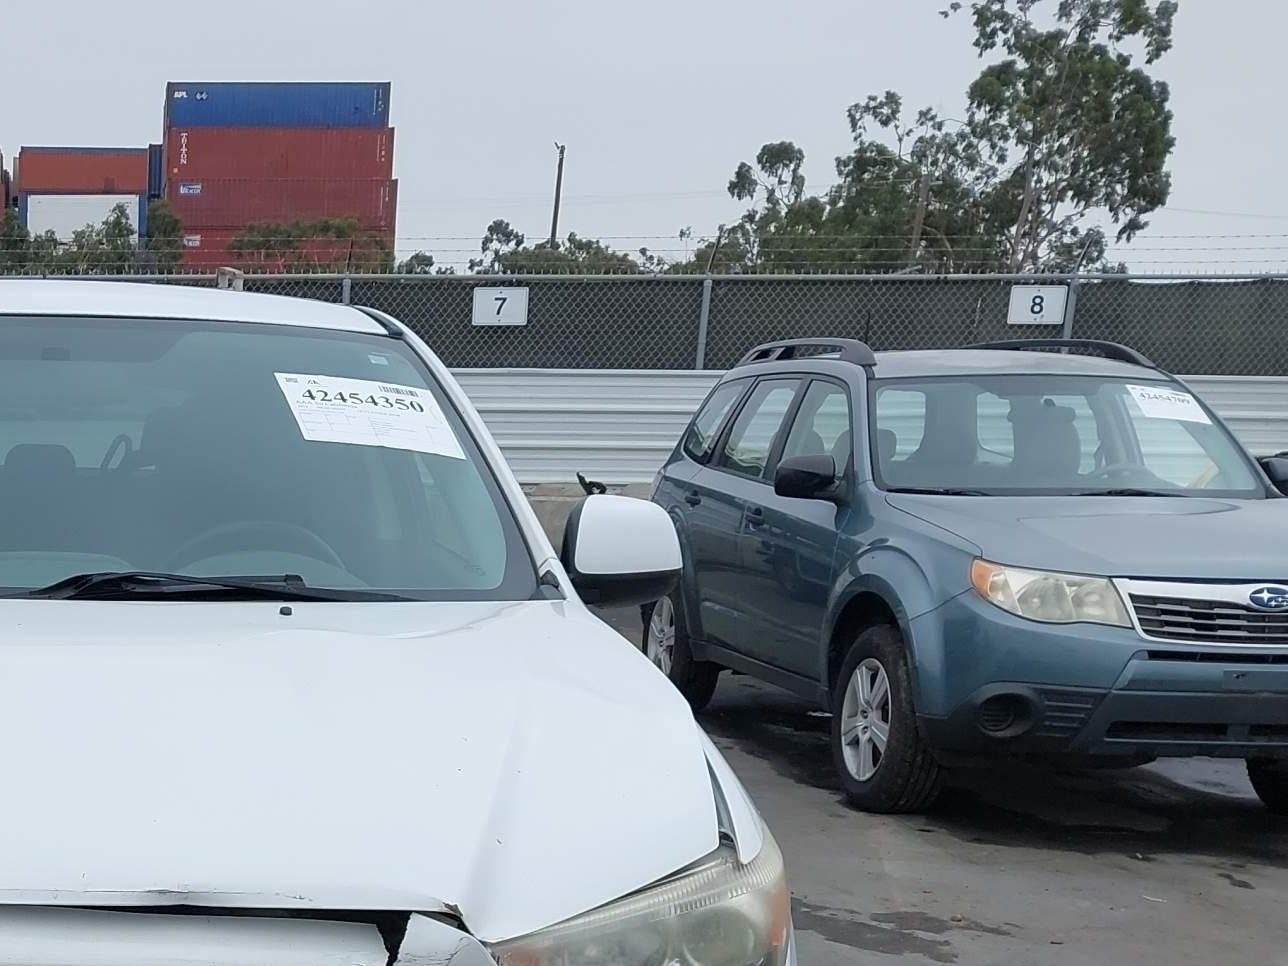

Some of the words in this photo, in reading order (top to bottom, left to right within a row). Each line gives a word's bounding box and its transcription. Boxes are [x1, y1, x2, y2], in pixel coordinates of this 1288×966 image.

[494, 297, 508, 316] 7
[1030, 295, 1044, 314] 8
[301, 389, 424, 413] 42454350
